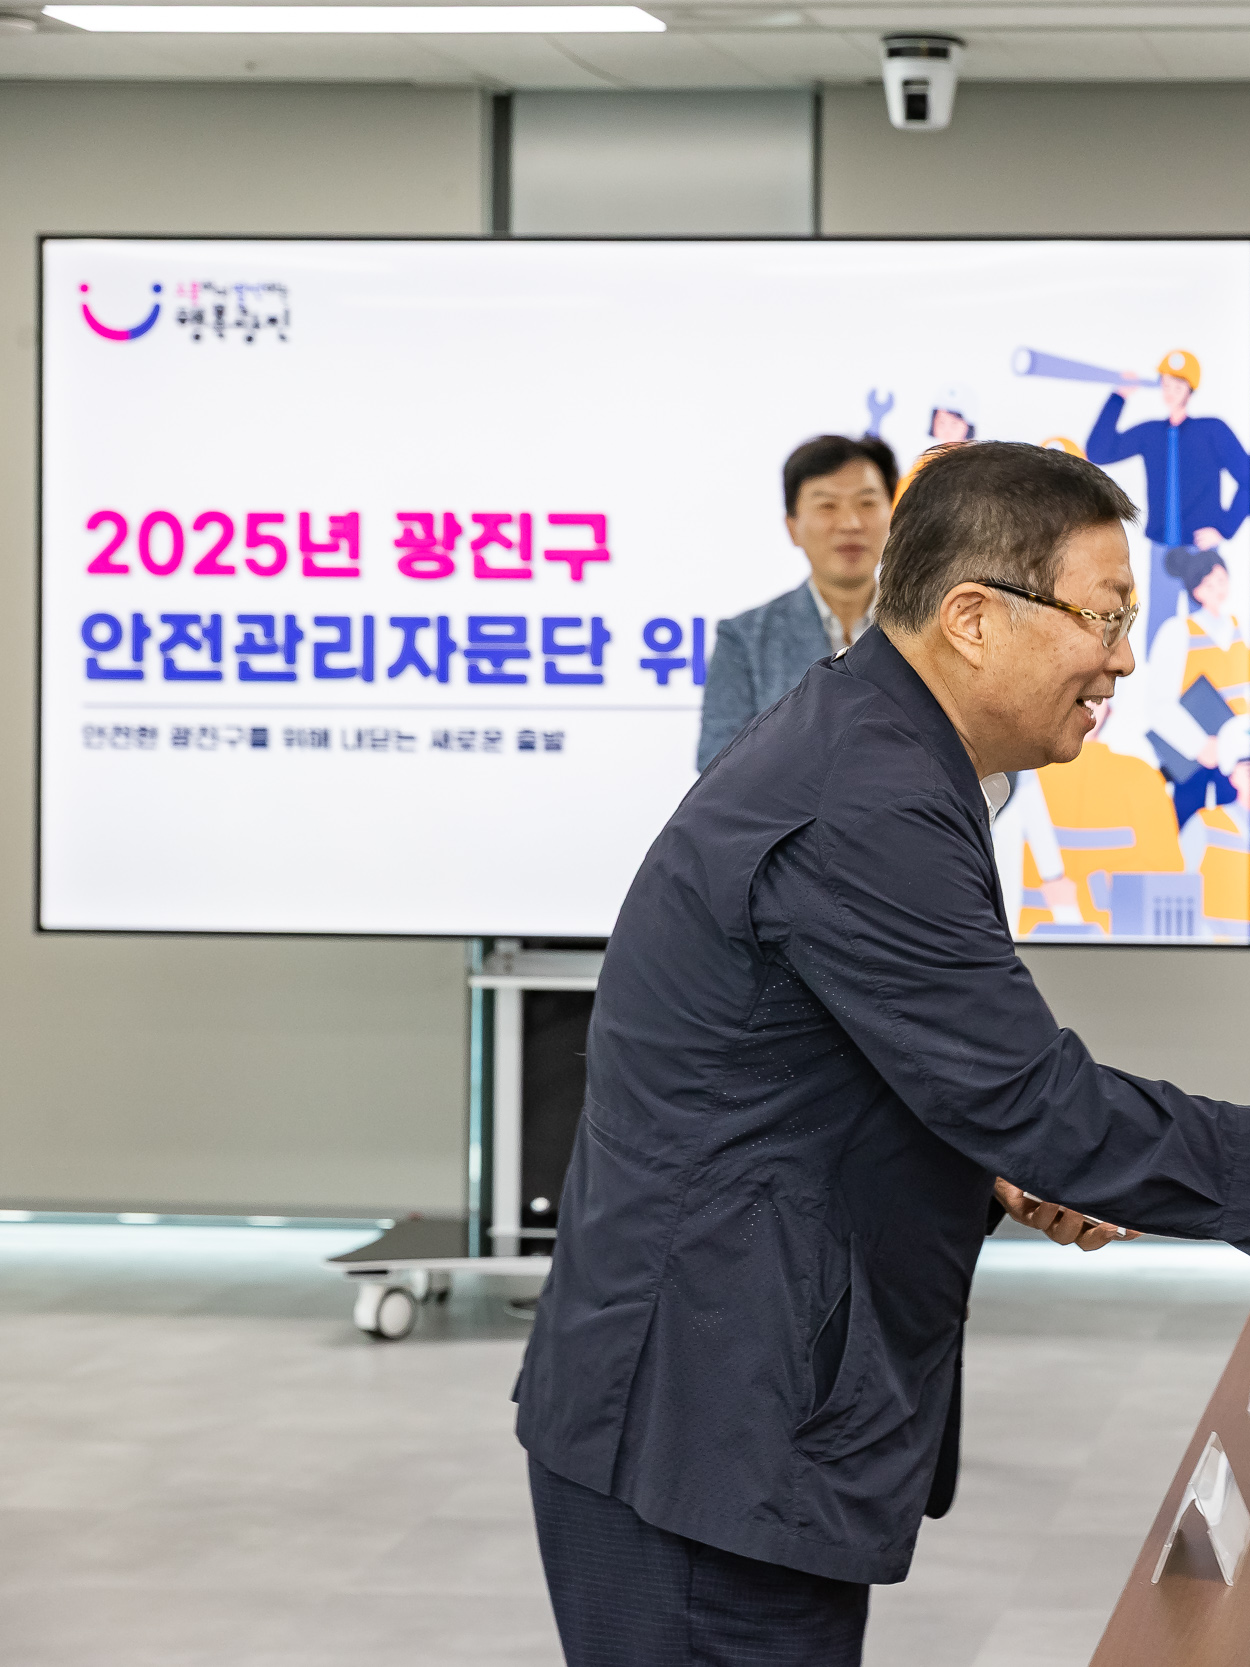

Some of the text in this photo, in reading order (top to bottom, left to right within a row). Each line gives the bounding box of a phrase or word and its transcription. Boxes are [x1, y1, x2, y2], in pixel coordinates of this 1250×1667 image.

[86, 510, 611, 582] 2025년 광진구
[81, 612, 611, 685] 안전관리자문단
[82, 725, 159, 750] 안전한
[170, 726, 271, 751] 광진구를
[282, 727, 333, 751] 위해
[431, 729, 503, 753] 새로운
[516, 728, 566, 754] 출발
